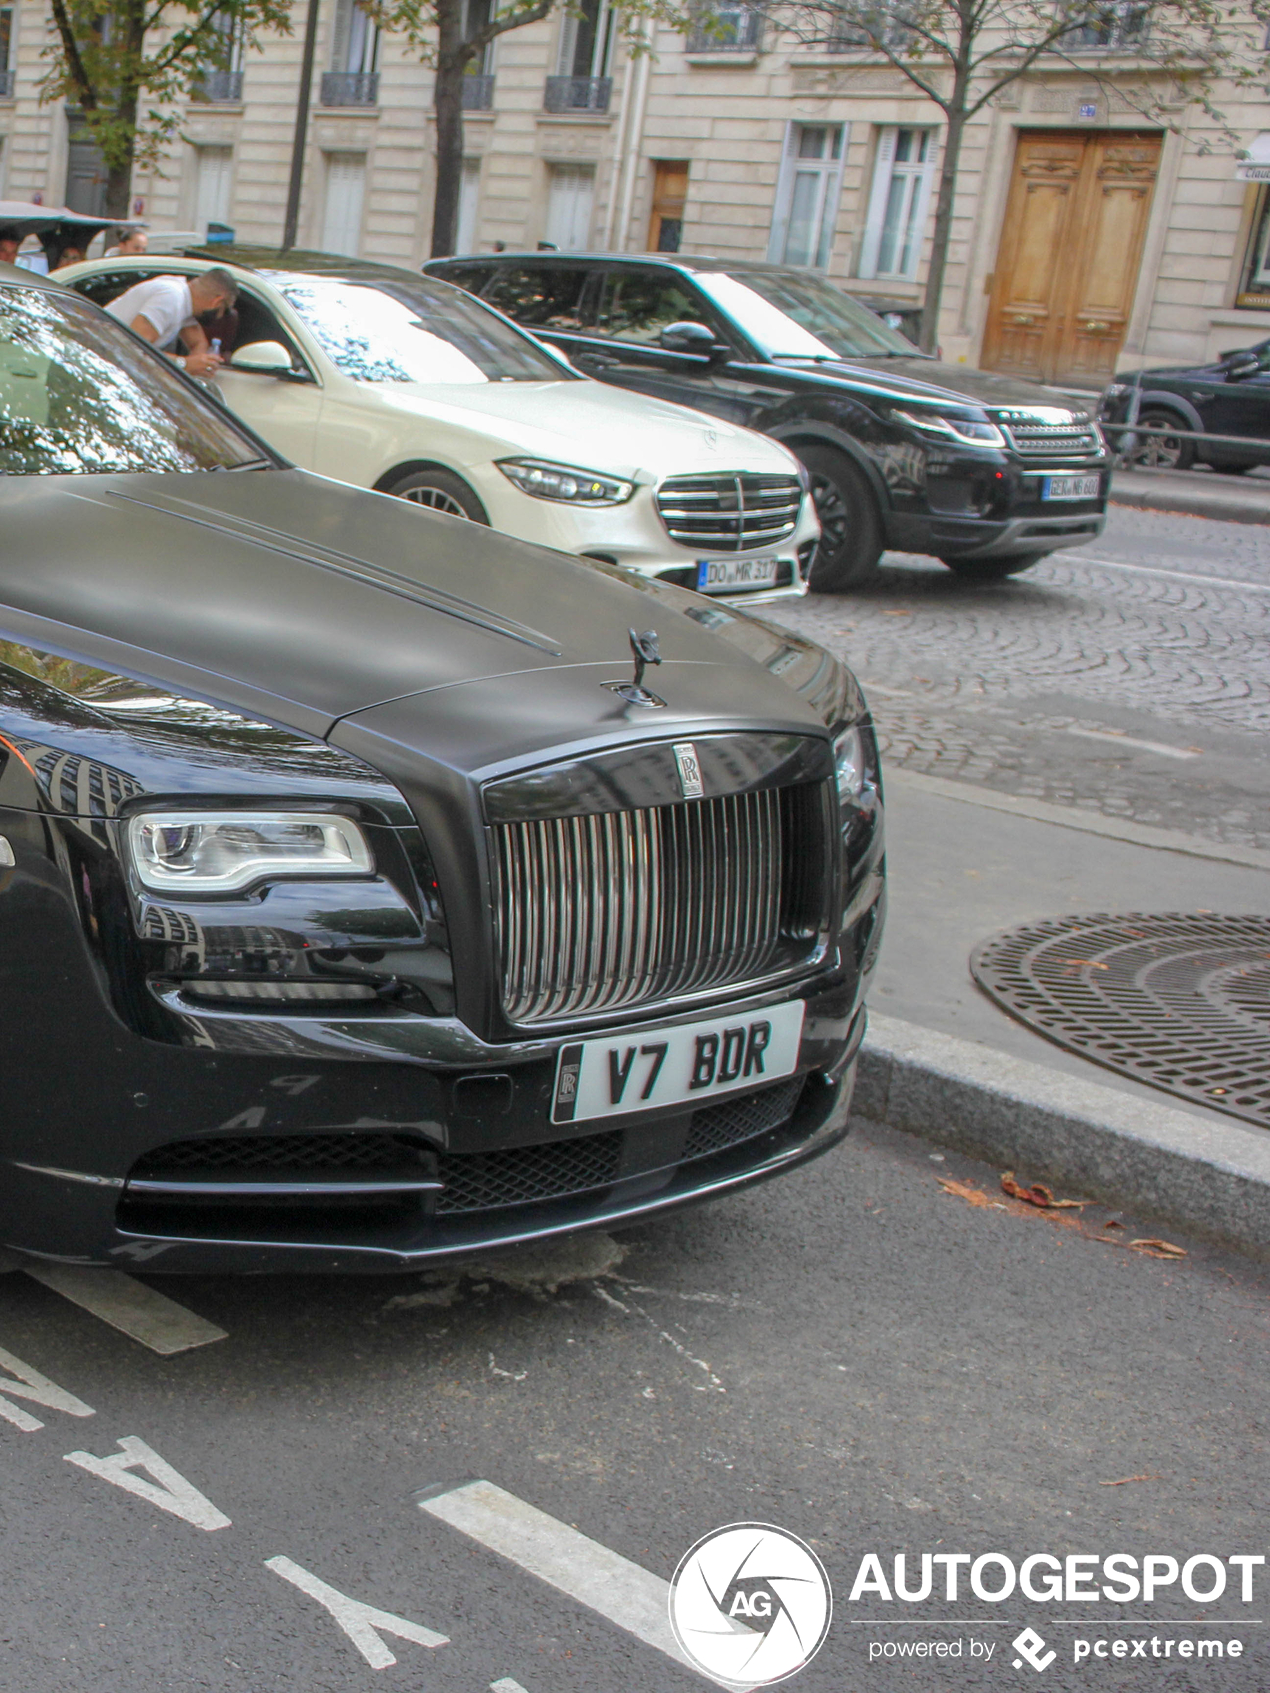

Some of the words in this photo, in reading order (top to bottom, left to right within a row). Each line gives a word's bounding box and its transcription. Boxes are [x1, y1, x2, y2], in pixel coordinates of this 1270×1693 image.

[1081, 104, 1095, 117] 27
[1051, 480, 1067, 496] GER
[1083, 478, 1098, 495] 600
[708, 564, 727, 583] DO
[735, 561, 753, 581] MR
[753, 558, 776, 580] 317
[608, 1040, 669, 1104] V7
[688, 1019, 773, 1091] BDR
